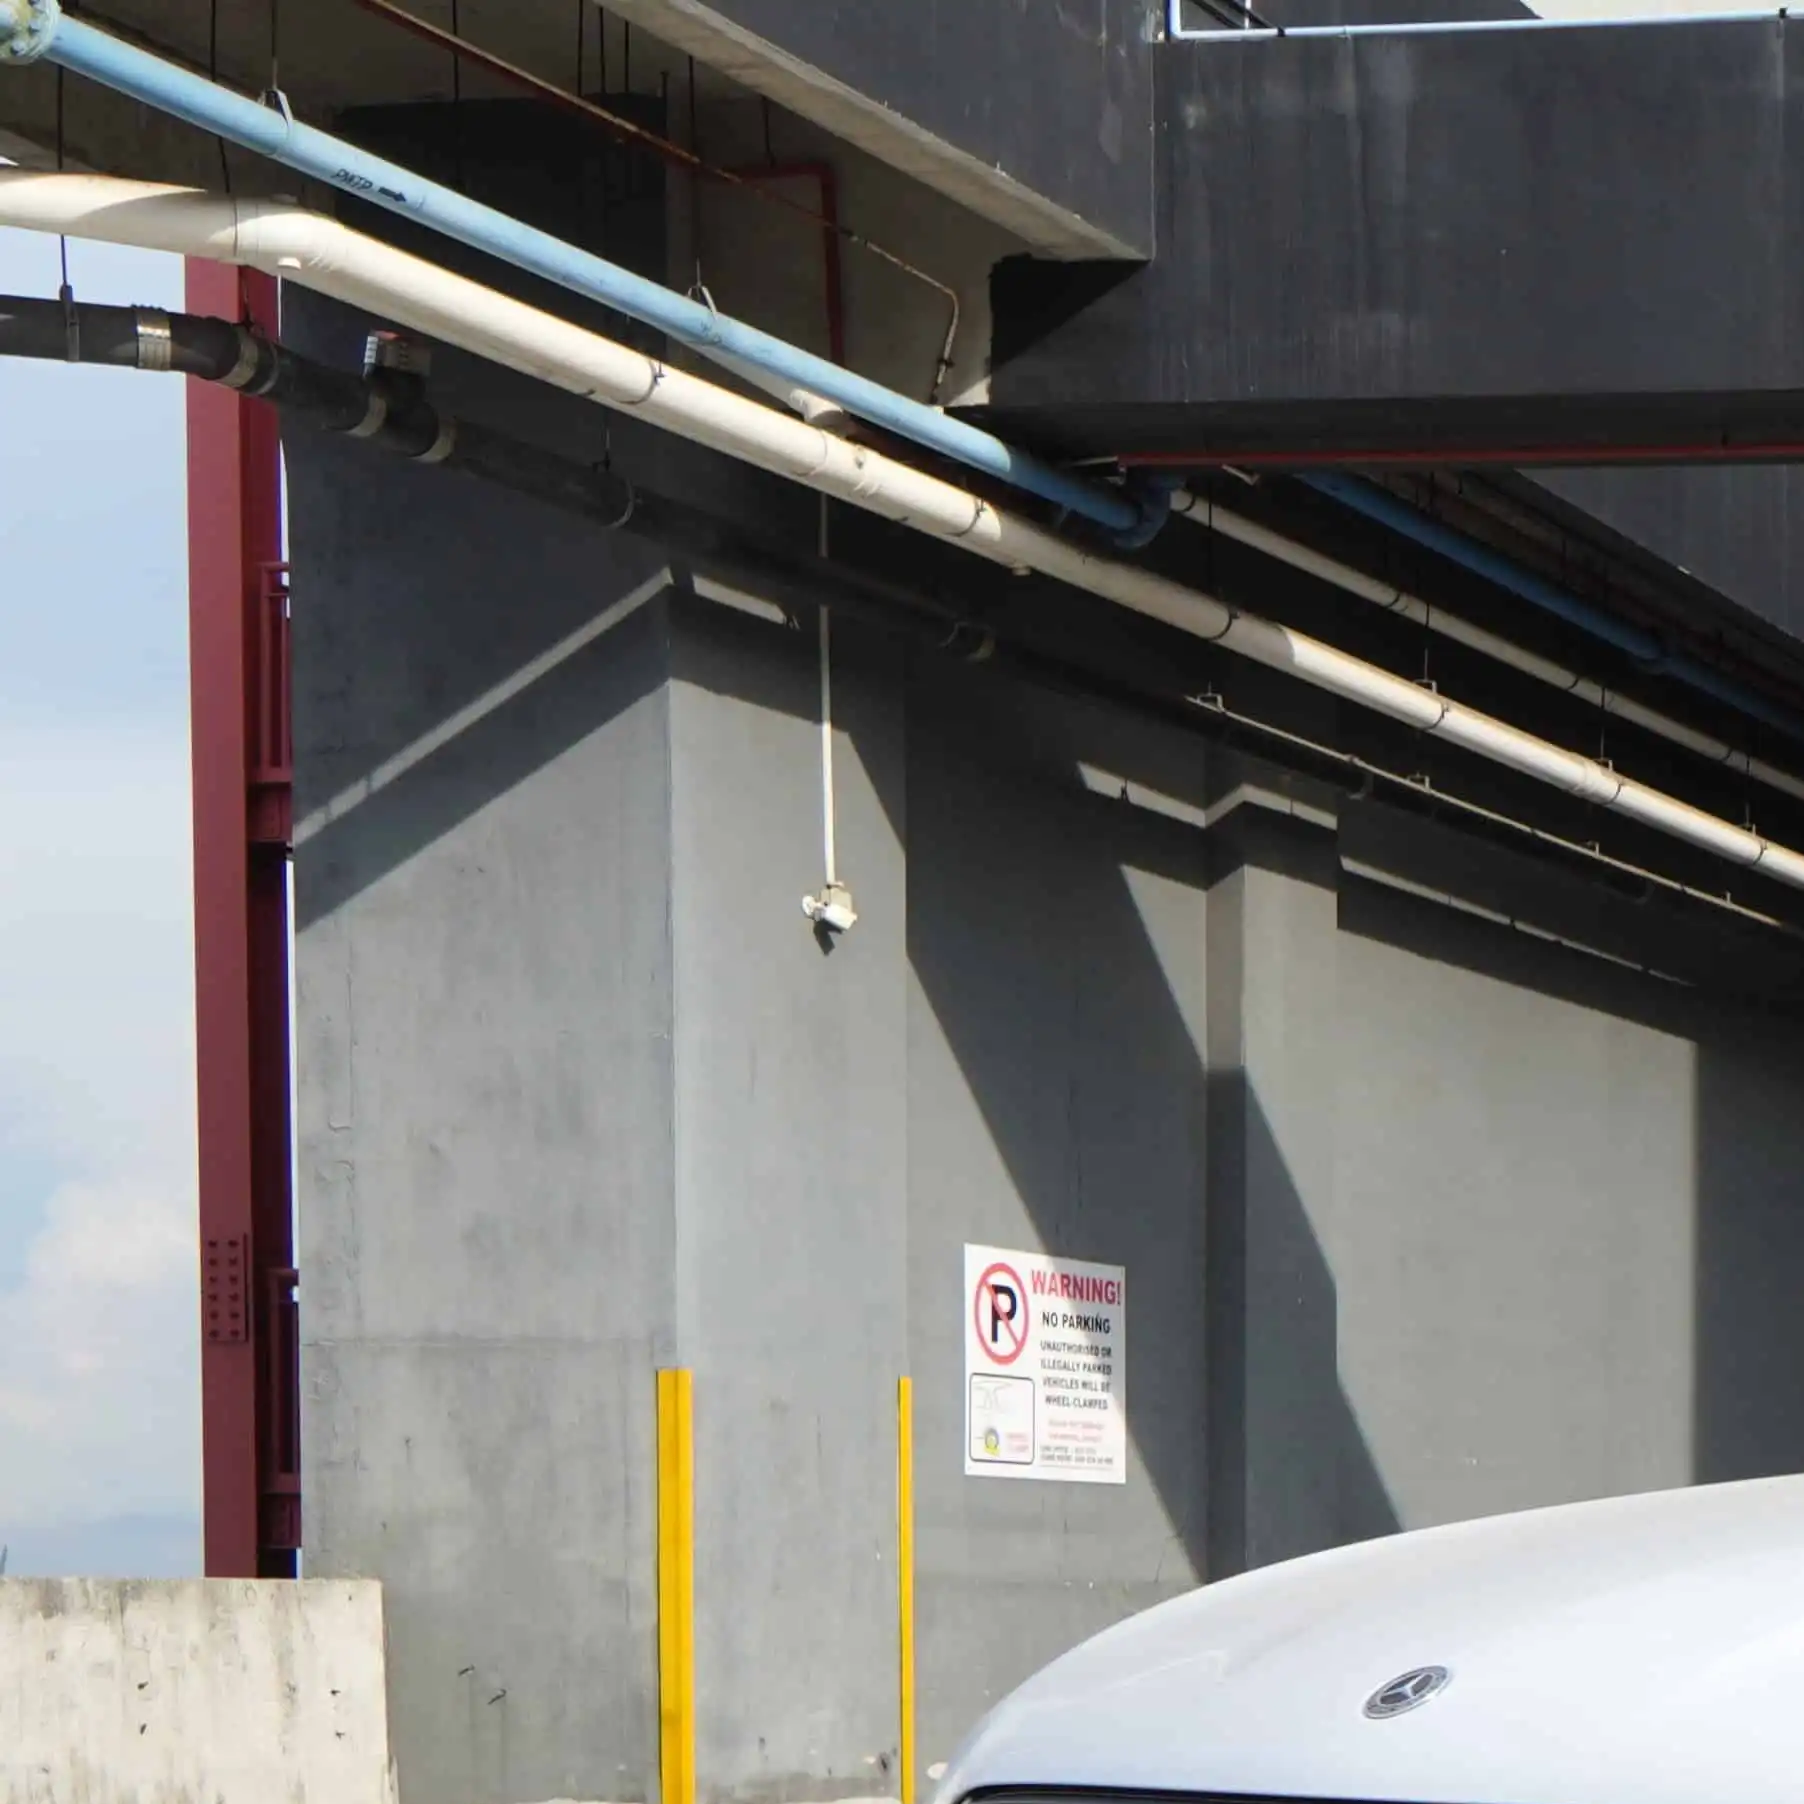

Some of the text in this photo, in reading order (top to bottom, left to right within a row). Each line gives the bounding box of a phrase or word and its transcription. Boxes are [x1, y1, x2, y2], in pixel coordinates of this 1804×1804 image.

[1031, 1269, 1121, 1306] WARNING!
[1042, 1311, 1111, 1334] NO PARKING
